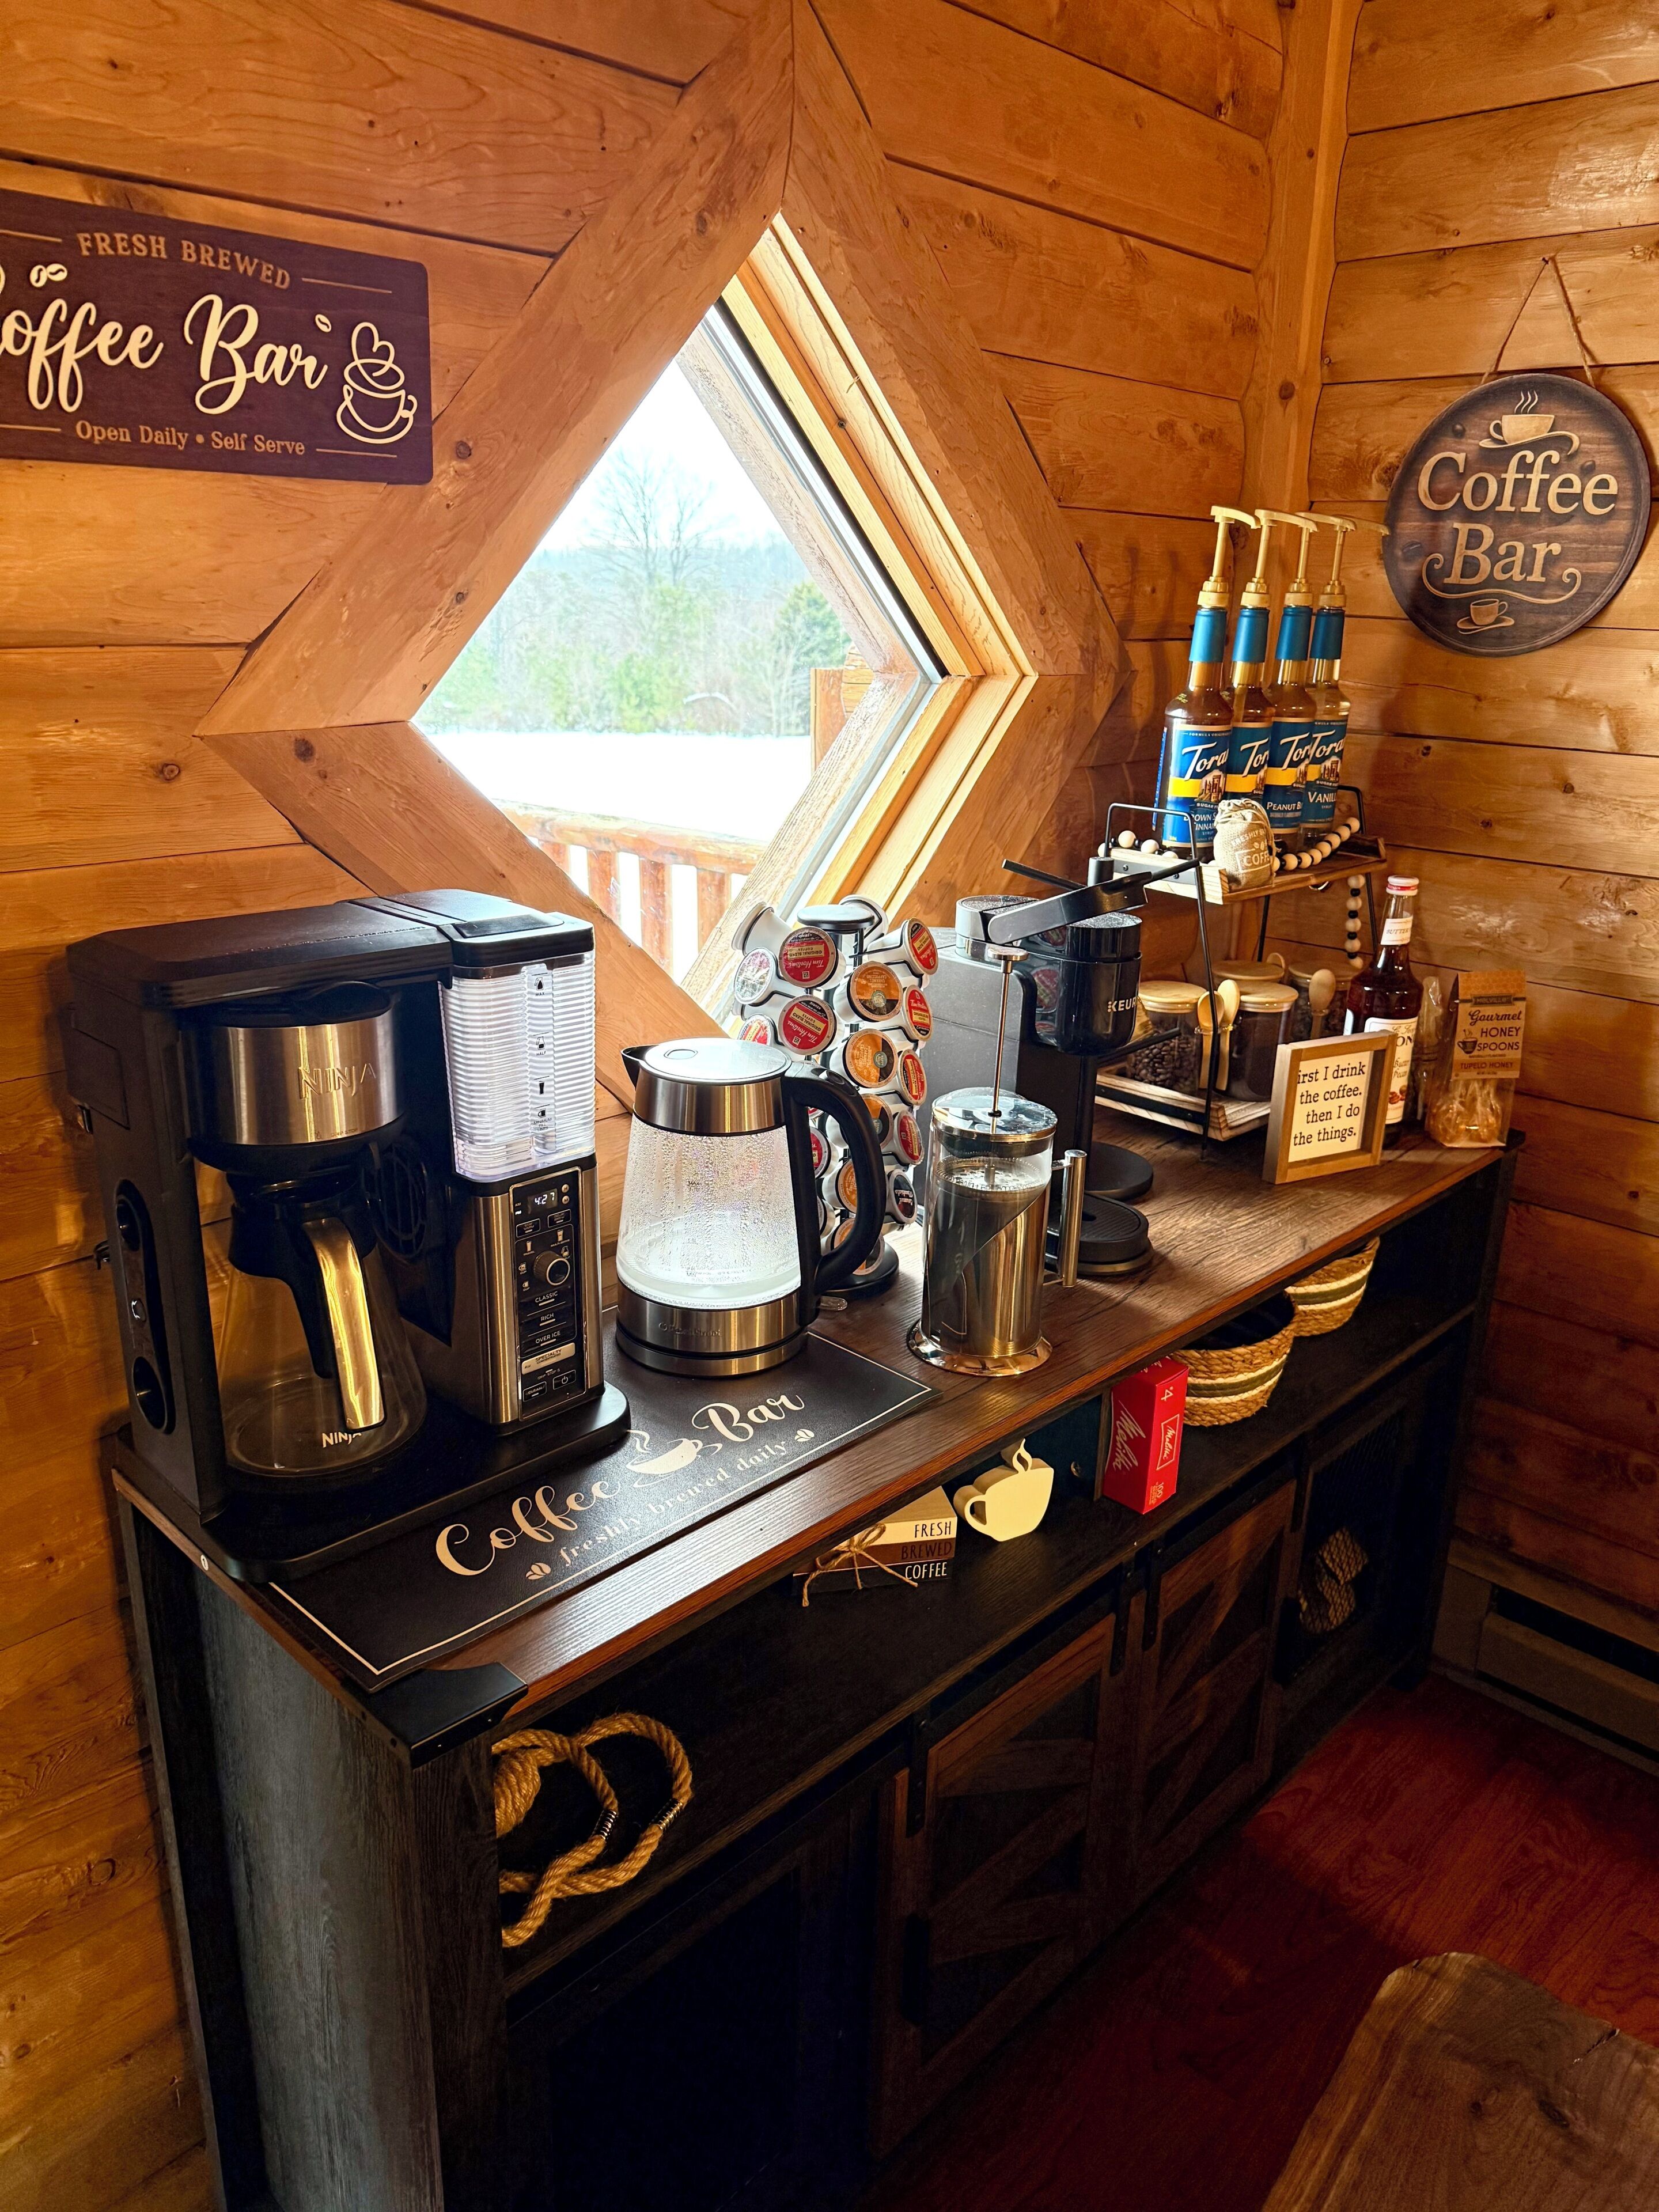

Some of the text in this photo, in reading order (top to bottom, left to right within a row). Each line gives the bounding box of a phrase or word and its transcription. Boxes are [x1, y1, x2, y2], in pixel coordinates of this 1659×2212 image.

[77, 233, 290, 289] FRESH BREWED
[184, 294, 328, 414] Bar
[76, 420, 305, 455] Open Daily Self Serve
[1418, 450, 1618, 516] Coffee
[1443, 522, 1561, 585] Bar
[1267, 801, 1296, 810] PEANUT
[812, 959, 824, 968] Tim
[792, 1012, 821, 1032] ORIGINAL BLEND
[1469, 1009, 1522, 1026] Gourmet
[787, 1020, 819, 1044] Tim Hortons
[1480, 1027, 1521, 1037] HONEY
[1476, 1041, 1520, 1051] SPOONS
[1323, 1066, 1330, 1080] I
[1332, 1061, 1366, 1080] drink
[298, 1063, 376, 1099] NINJA
[1300, 1084, 1362, 1105] the coffee.
[1306, 1103, 1360, 1124] then I do
[1293, 1126, 1356, 1146] the things.
[535, 1192, 555, 1206] 4:27
[535, 1291, 559, 1304] CLASSIC
[540, 1313, 554, 1321] RICH
[535, 1330, 561, 1344] OVER ICE
[535, 1348, 562, 1362] SPECIALTY
[692, 1391, 805, 1442] Bar
[560, 1440, 787, 1567] freshly brewed daily
[435, 1480, 622, 1576] Coffee
[914, 1521, 952, 1538] FRESH
[901, 1541, 952, 1560] BREWED
[905, 1562, 948, 1580] COFFEE
